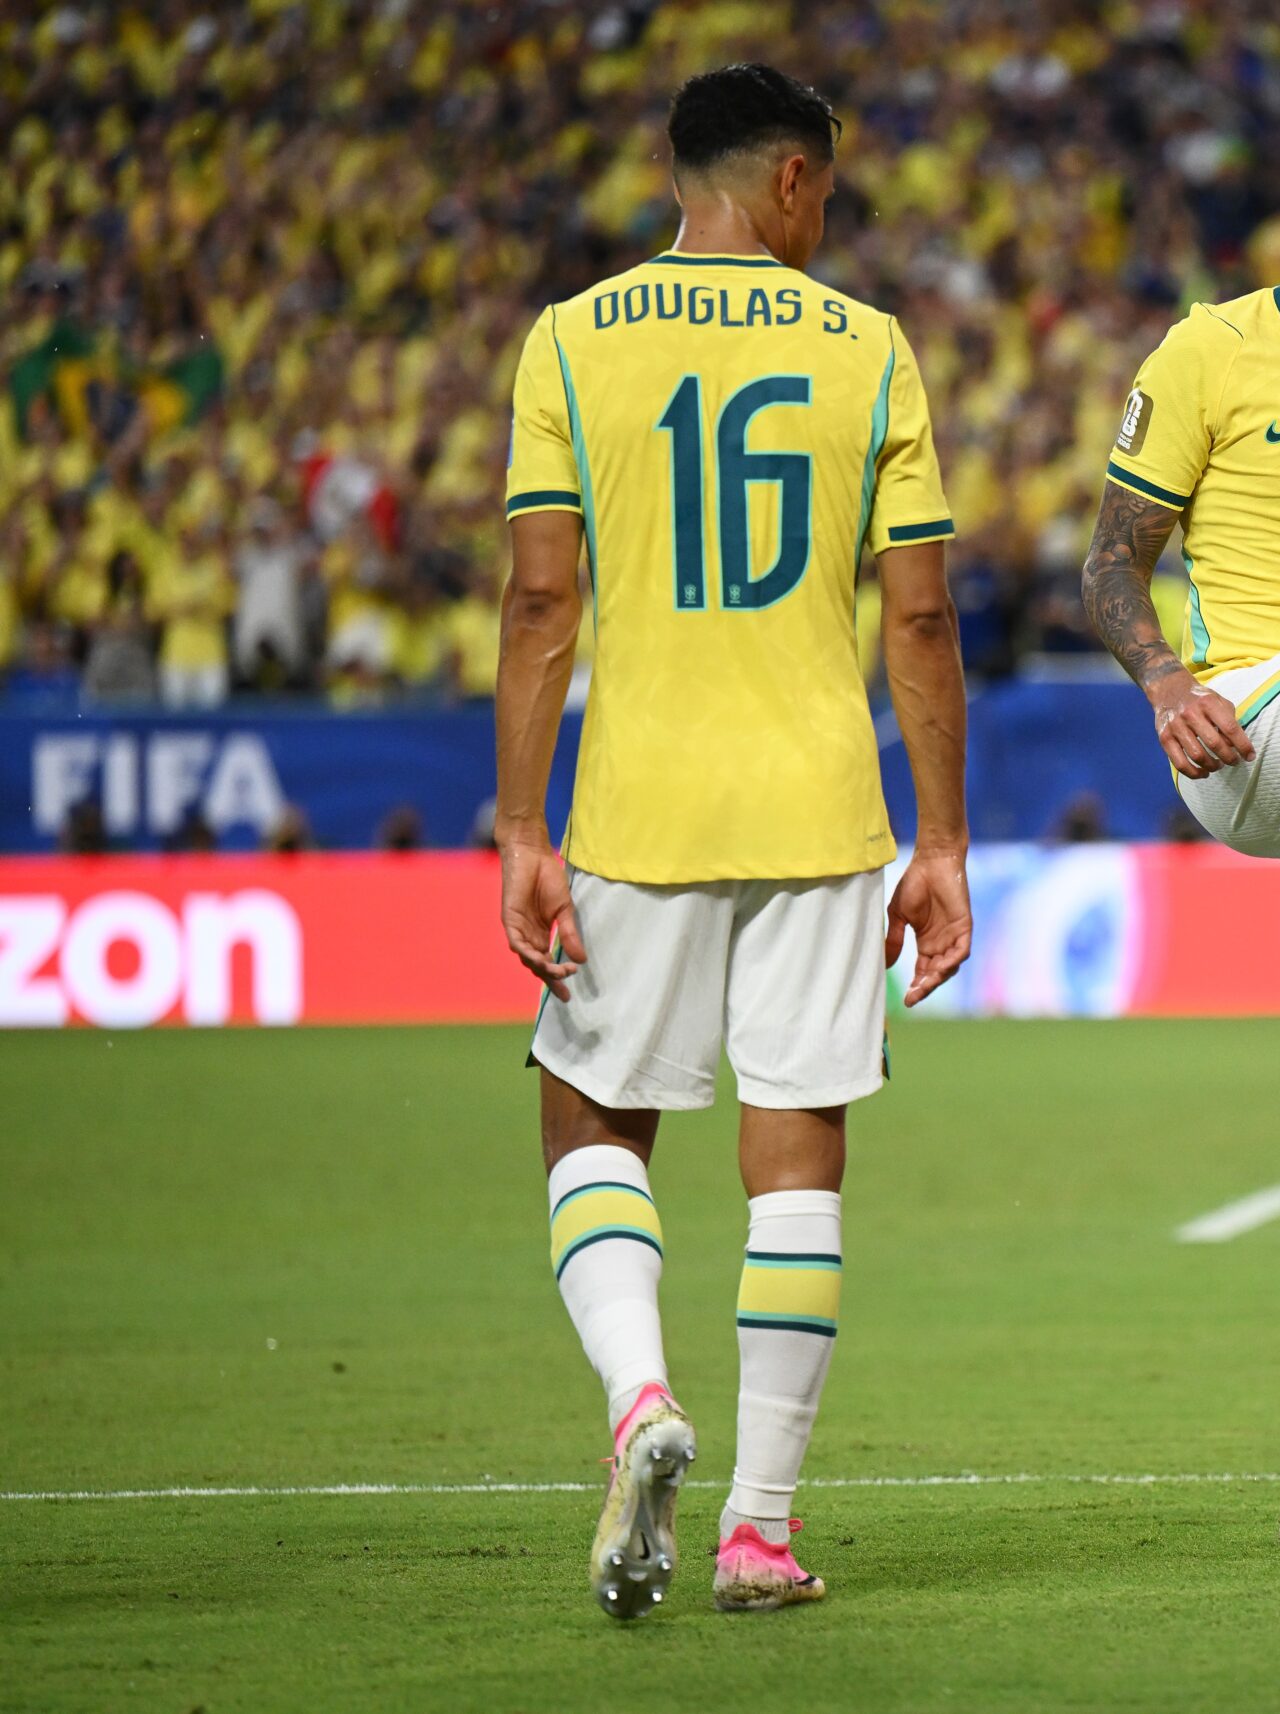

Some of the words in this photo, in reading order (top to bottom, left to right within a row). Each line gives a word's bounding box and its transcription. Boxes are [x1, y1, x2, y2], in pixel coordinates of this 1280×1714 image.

[594, 283, 802, 330] DOUGLAS
[823, 299, 859, 340] S.
[653, 373, 813, 612] 16
[33, 733, 284, 836] FIFA
